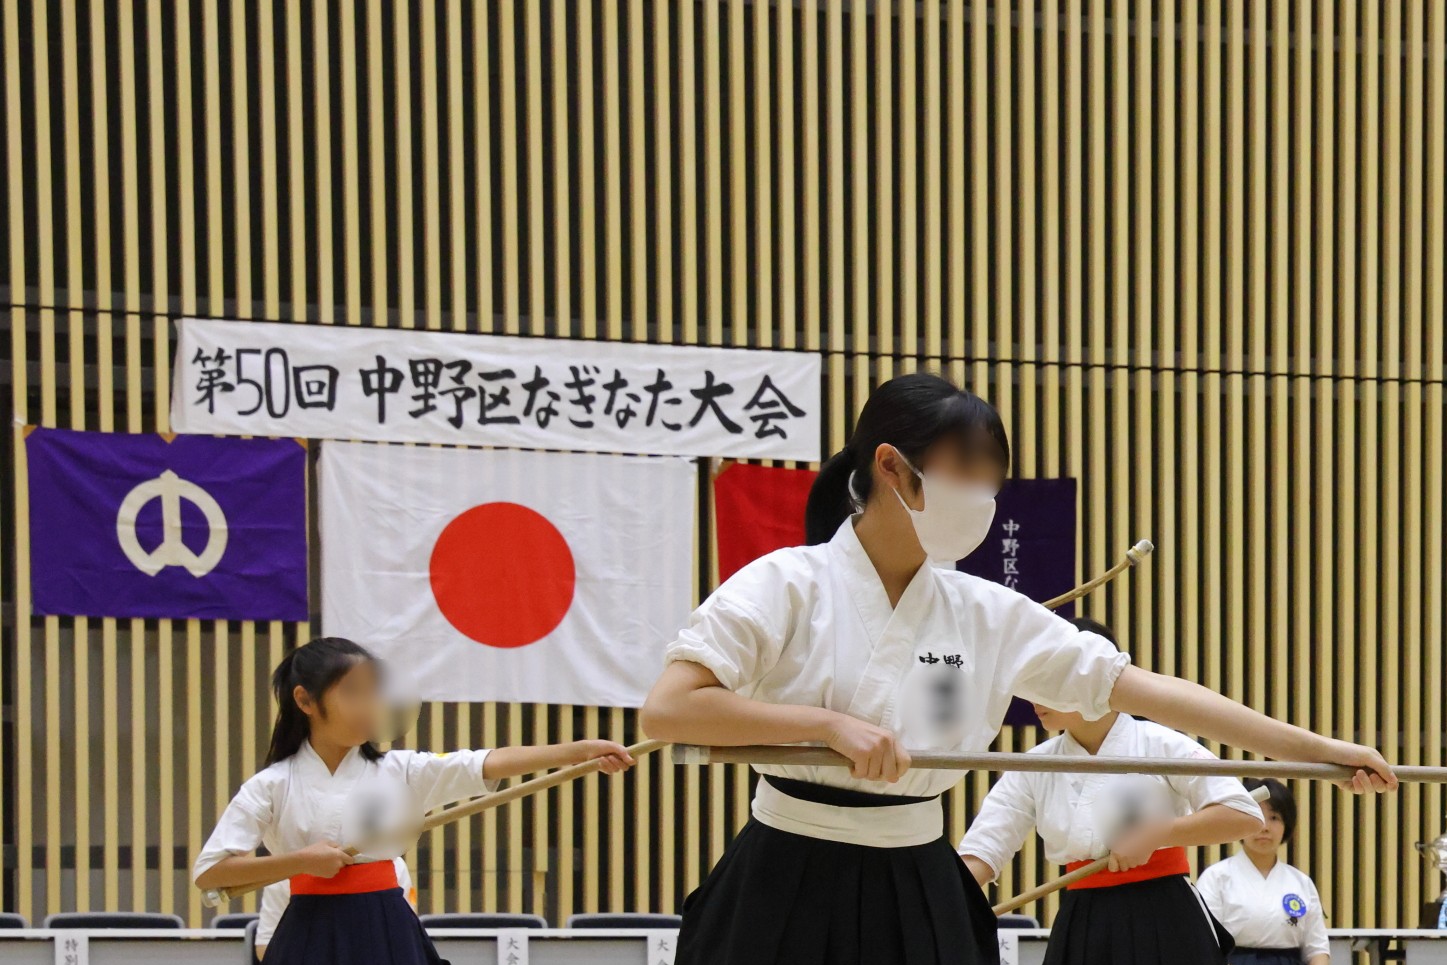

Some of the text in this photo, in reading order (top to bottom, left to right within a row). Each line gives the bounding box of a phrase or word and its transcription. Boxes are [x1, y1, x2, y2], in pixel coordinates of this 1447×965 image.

[191, 347, 807, 440] 第50回 中野区なぎなた大会
